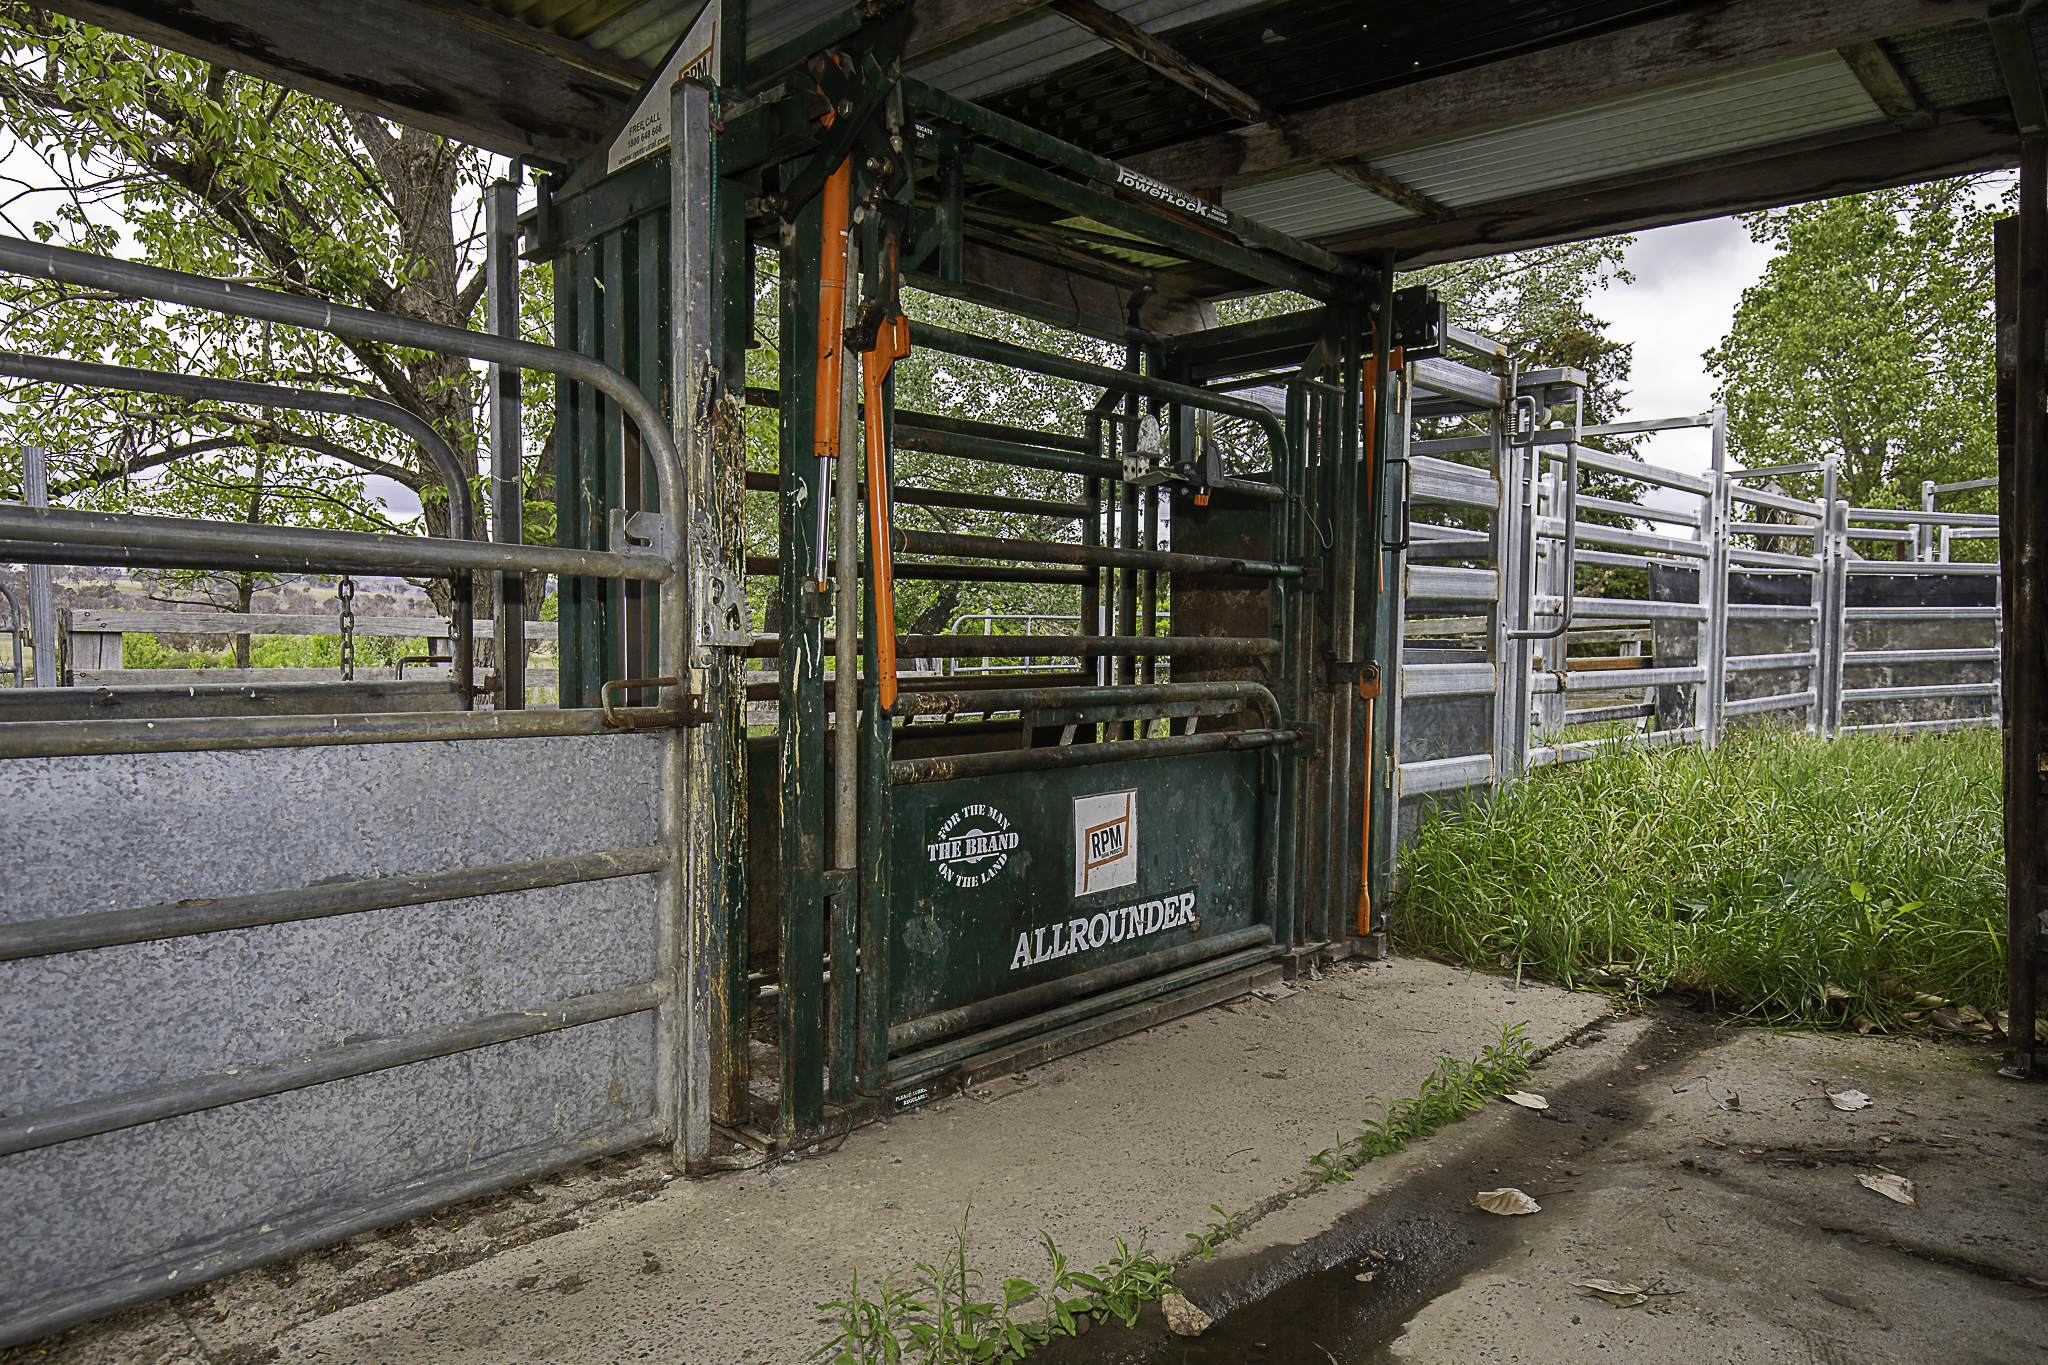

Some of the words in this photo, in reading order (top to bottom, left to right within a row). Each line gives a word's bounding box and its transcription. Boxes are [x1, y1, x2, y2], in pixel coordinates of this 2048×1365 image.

[629, 120, 645, 136] FREE
[645, 112, 661, 127] CALL
[627, 135, 640, 149] 1800
[938, 812, 961, 840] FOR
[962, 804, 986, 818] THE
[987, 806, 1011, 831] MAN
[927, 840, 962, 862] THE
[965, 832, 1019, 856] BRAND
[1091, 825, 1122, 859] RPM
[938, 863, 955, 882] ON
[955, 875, 979, 888] THE
[981, 853, 1008, 884] LAND
[1010, 892, 1196, 970] ALLROUNDER
